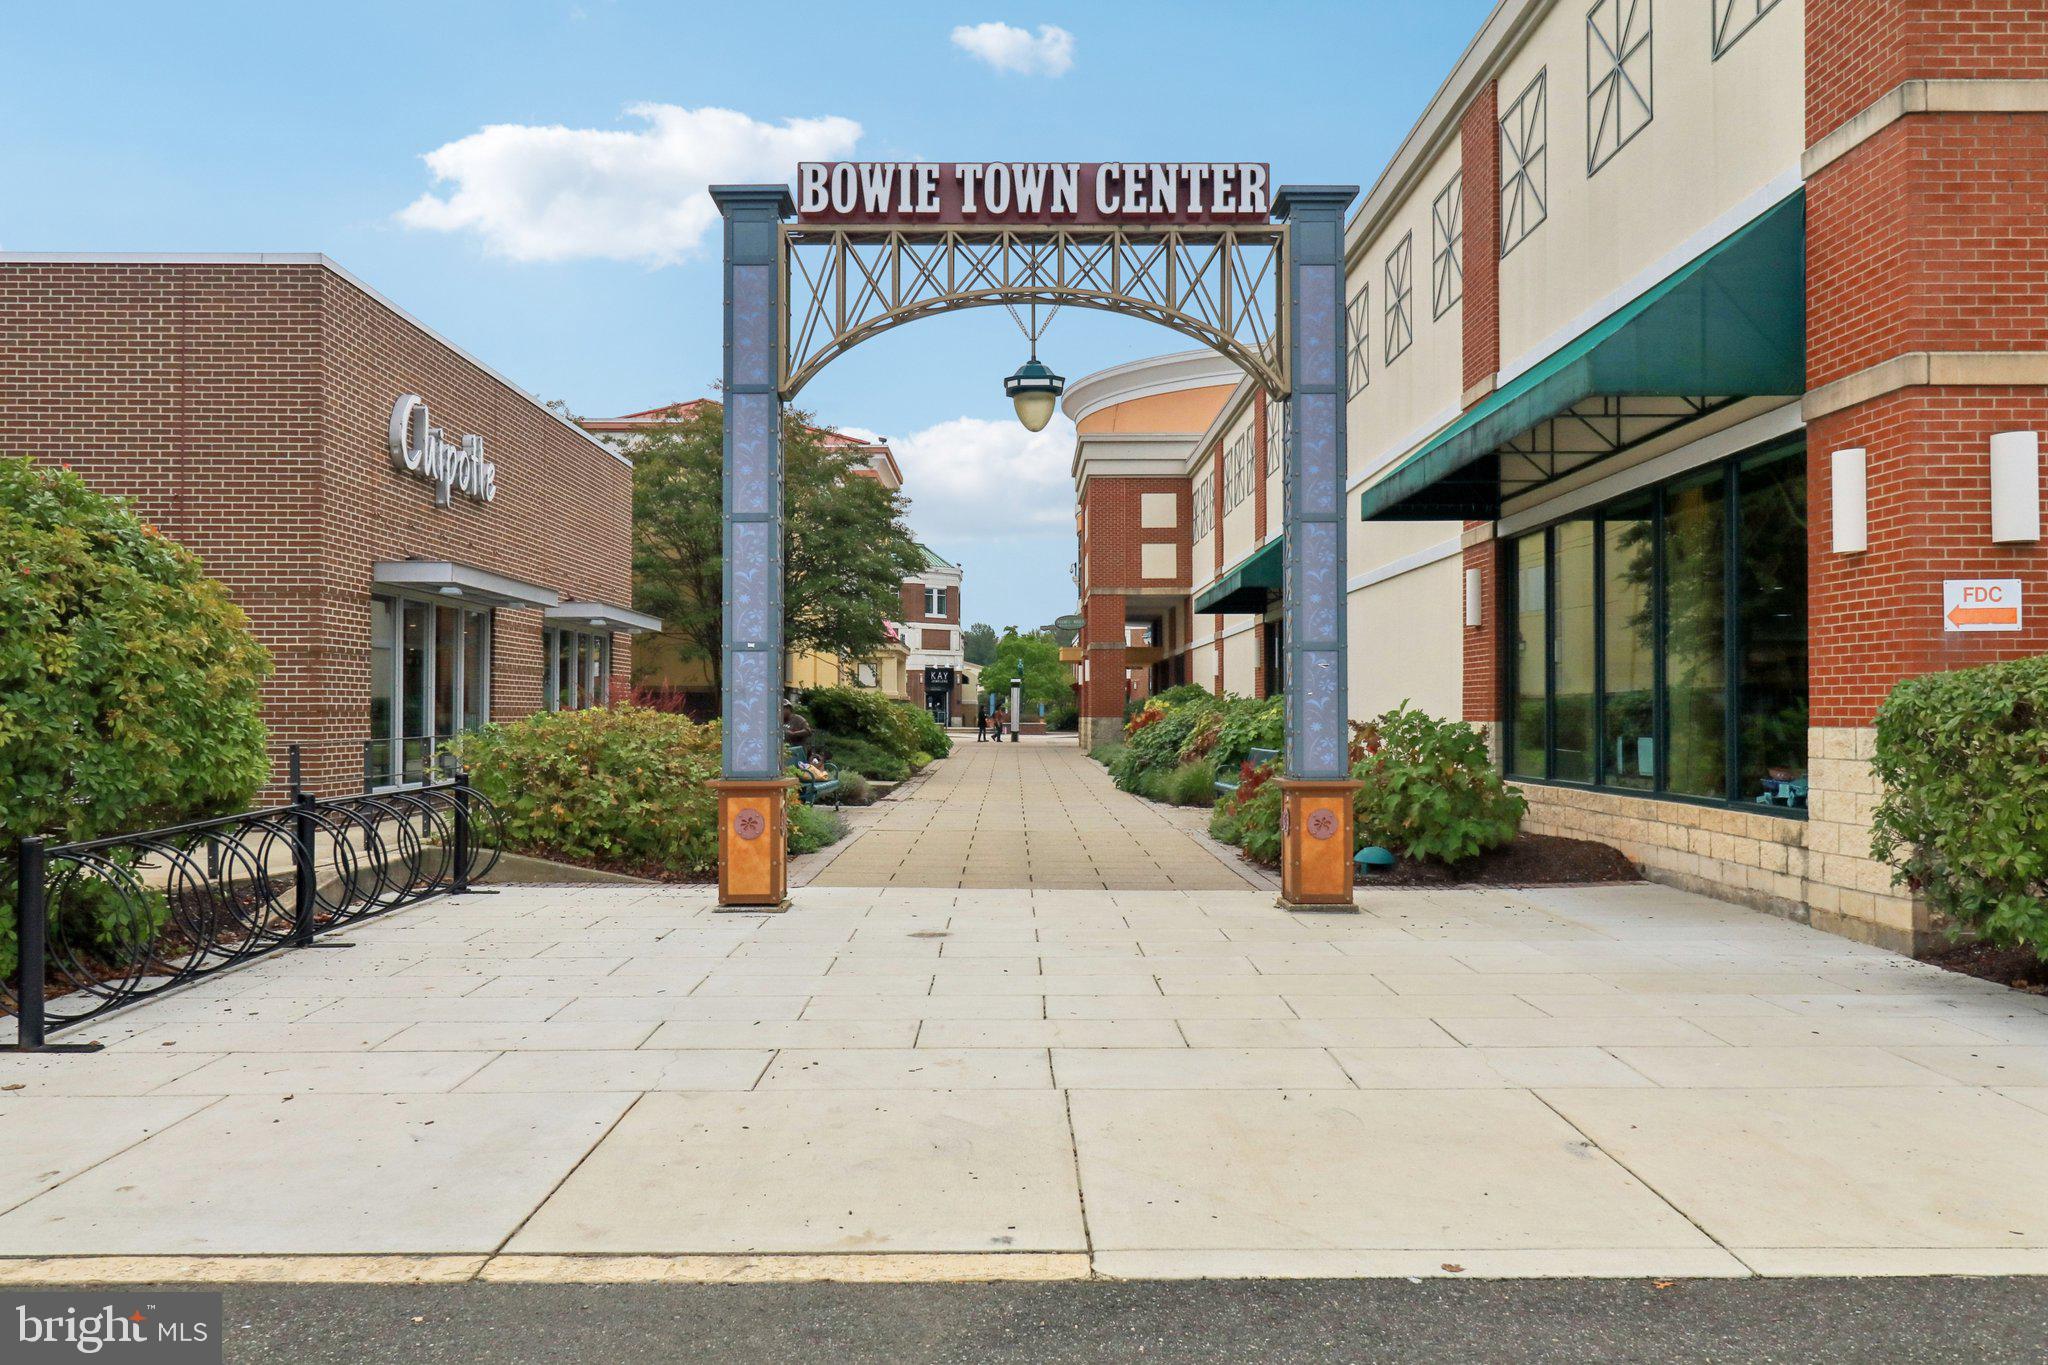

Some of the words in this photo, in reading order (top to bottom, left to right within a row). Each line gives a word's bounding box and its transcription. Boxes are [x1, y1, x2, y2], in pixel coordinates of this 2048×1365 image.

[801, 162, 940, 214] BOWIE
[956, 162, 1080, 214] TOWN
[1096, 162, 1267, 214] CENTER
[389, 393, 496, 508] Chipotle
[1963, 586, 2002, 602] FDC
[930, 671, 948, 680] KAY
